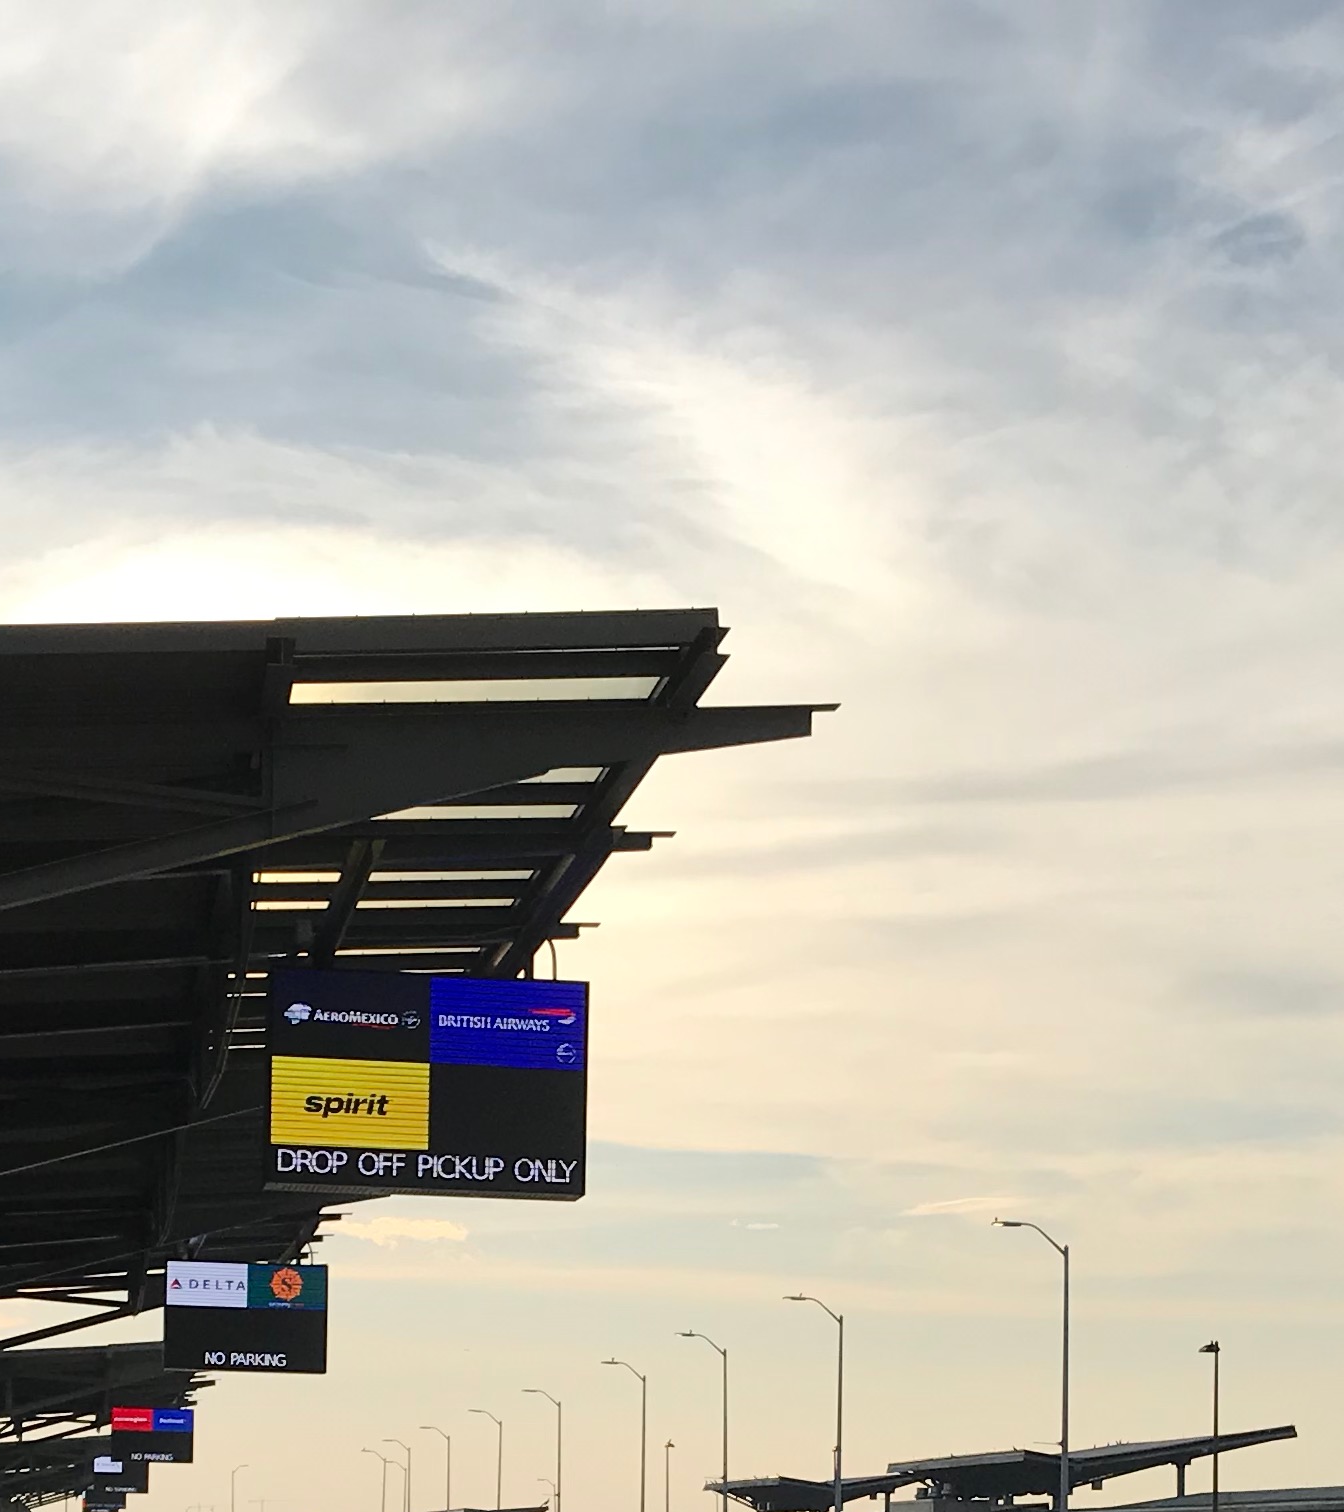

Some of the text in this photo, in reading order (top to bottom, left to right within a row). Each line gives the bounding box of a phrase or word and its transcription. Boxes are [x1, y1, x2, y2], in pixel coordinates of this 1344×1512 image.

[312, 1008, 399, 1026] AEROMEXICO
[438, 1014, 551, 1032] BRITISH AIRWAYS
[303, 1092, 390, 1119] spirit
[276, 1148, 578, 1184] DROP OFF PICKUP ONLY
[188, 1278, 246, 1291] DELTA
[204, 1351, 287, 1367] NO PARKING
[130, 1453, 174, 1461] NO PARKING
